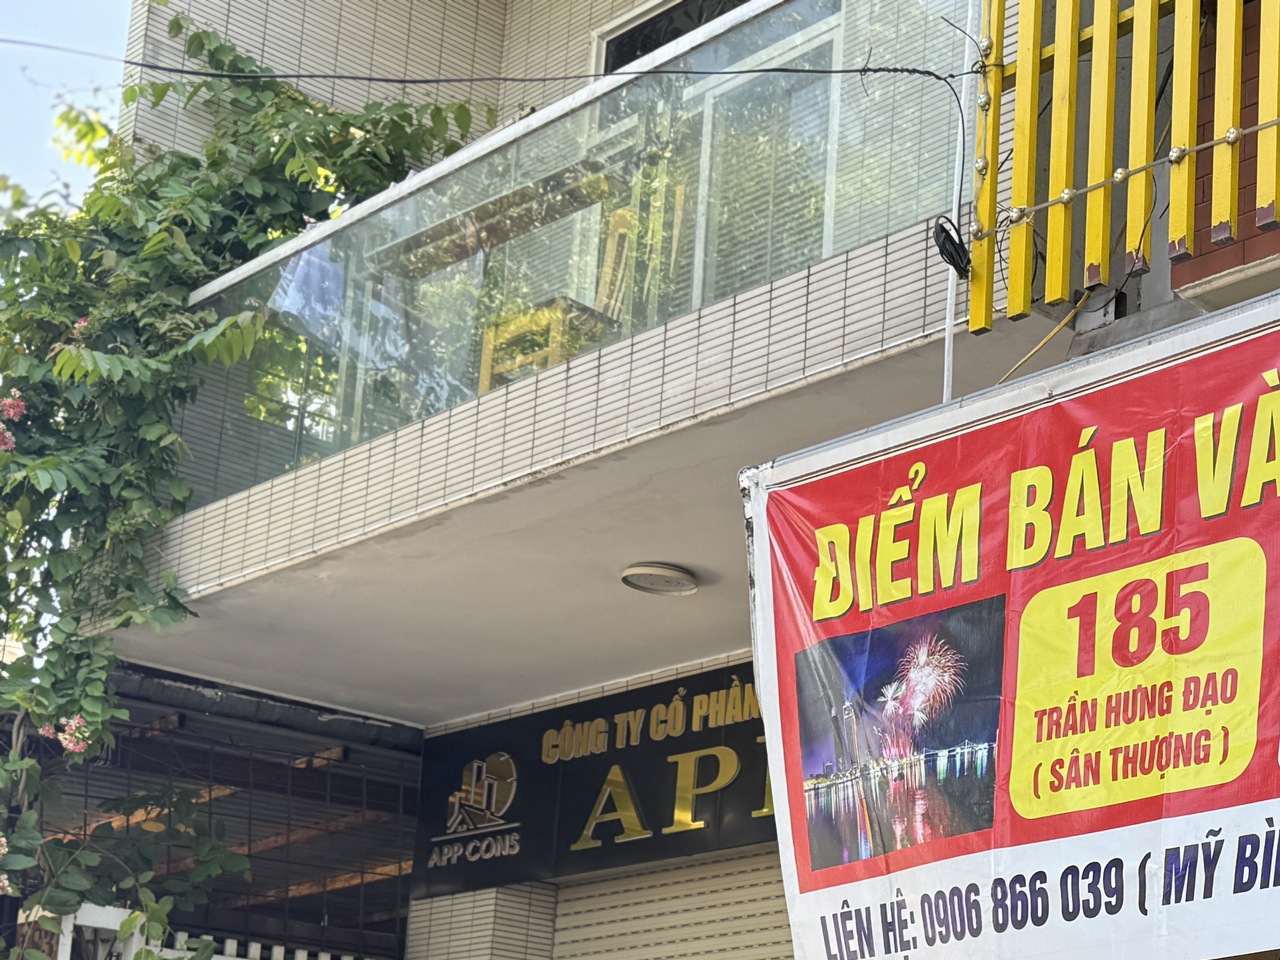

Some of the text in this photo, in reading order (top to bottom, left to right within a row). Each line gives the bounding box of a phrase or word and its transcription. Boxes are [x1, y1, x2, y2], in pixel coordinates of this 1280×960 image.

[812, 462, 984, 623] ĐIỂM
[1006, 427, 1168, 571] BÁN
[1067, 562, 1210, 679] 185
[541, 718, 609, 764] CÔNG
[614, 708, 647, 749] TY
[650, 687, 688, 741] CỔ
[1034, 667, 1238, 743] TRẦN HƯNG ĐẠO
[1032, 725, 1230, 799] ( SÂN THƯỢNG )
[427, 832, 520, 868] APP CONS
[920, 883, 983, 948] 0906
[992, 870, 1049, 933] 866
[1060, 857, 1125, 922] 039
[1137, 851, 1152, 917] (
[1161, 827, 1225, 907] MỸ
